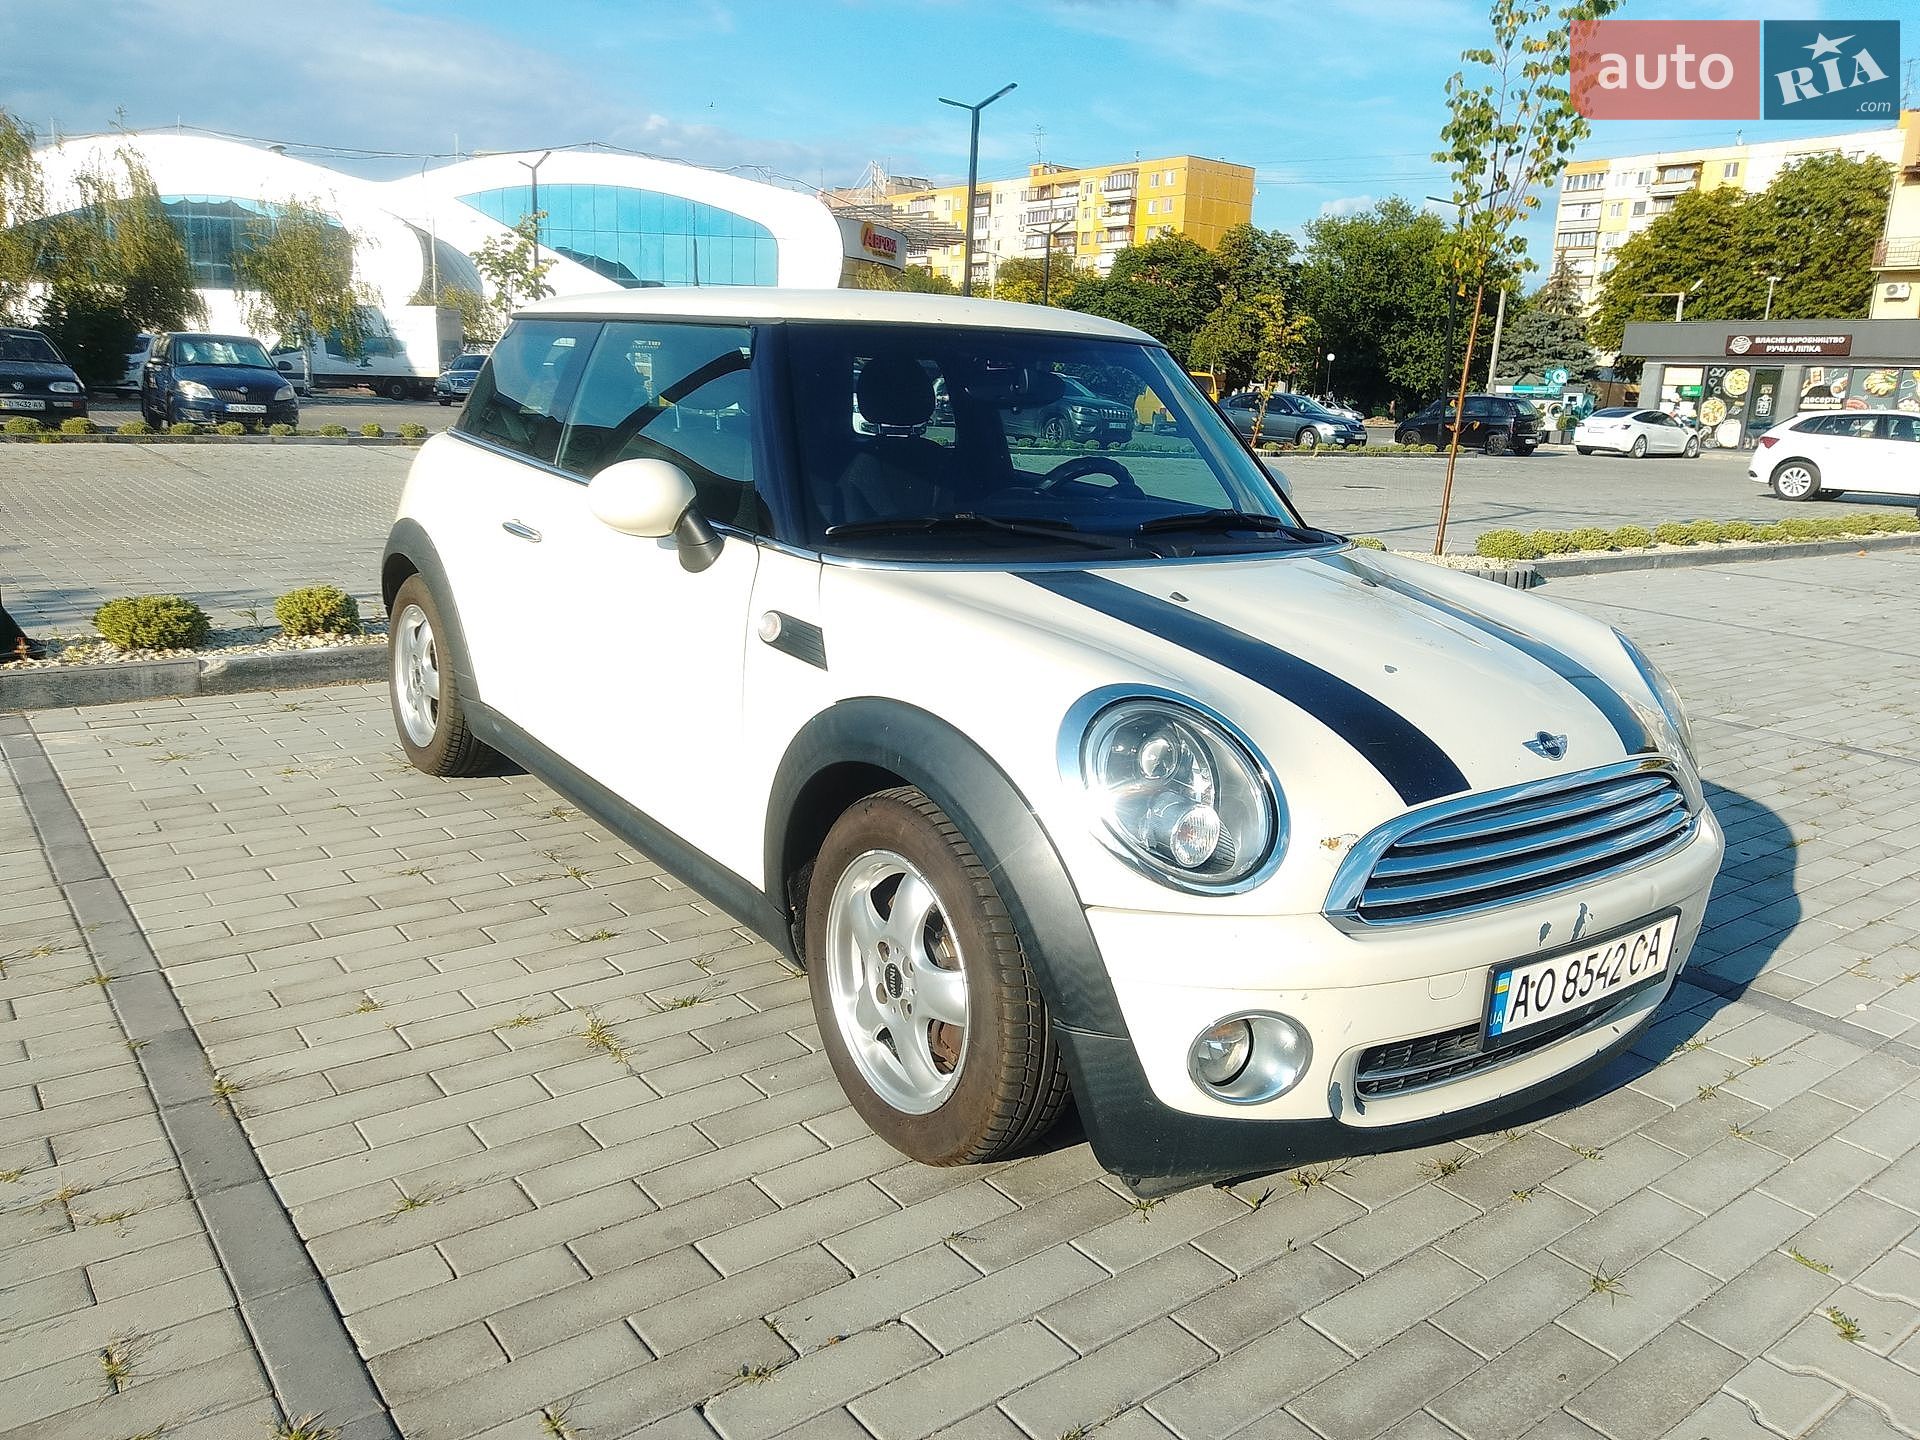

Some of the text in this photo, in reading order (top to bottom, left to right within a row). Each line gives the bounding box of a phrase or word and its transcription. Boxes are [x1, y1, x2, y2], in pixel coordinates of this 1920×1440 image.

[1755, 336, 1846, 345] ВЛАСНЕ ВИРОБНИЦТВО
[1766, 345, 1821, 353] РУЧНА ЛІПКА
[1509, 927, 1662, 1024] AO 8542 CA
[1489, 1010, 1503, 1026] UA
